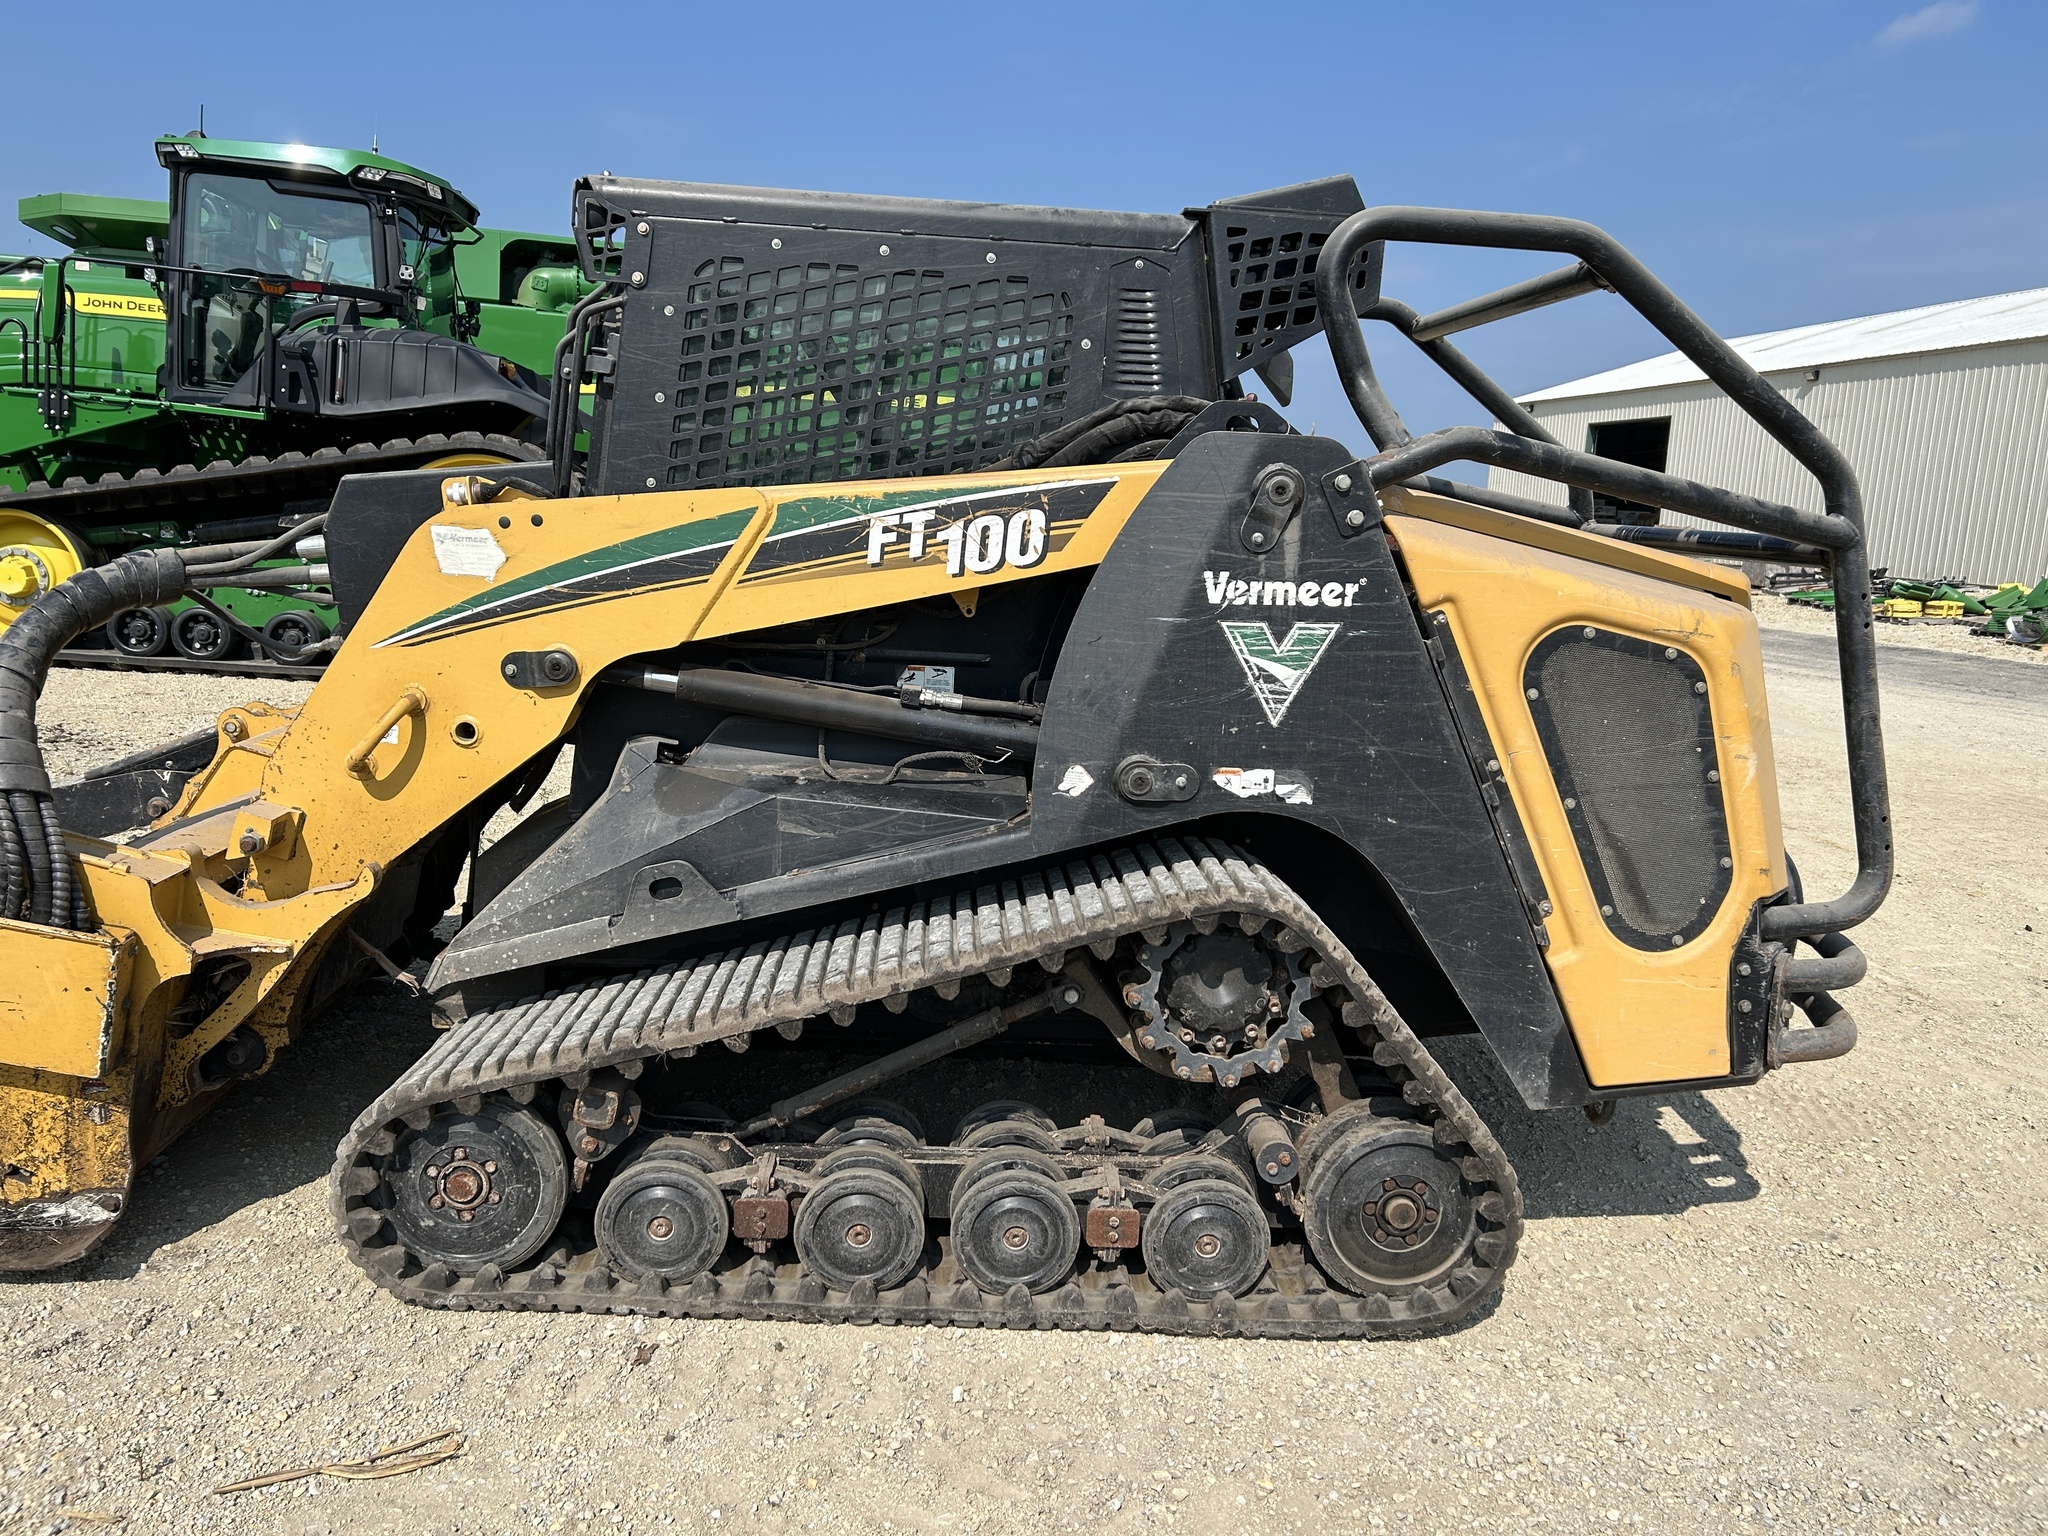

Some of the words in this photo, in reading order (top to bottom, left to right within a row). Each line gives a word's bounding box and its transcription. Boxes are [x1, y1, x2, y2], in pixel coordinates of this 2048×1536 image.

[83, 297, 122, 310] JOHN
[127, 301, 166, 314] DEER
[1203, 571, 1360, 607] Vermeer
